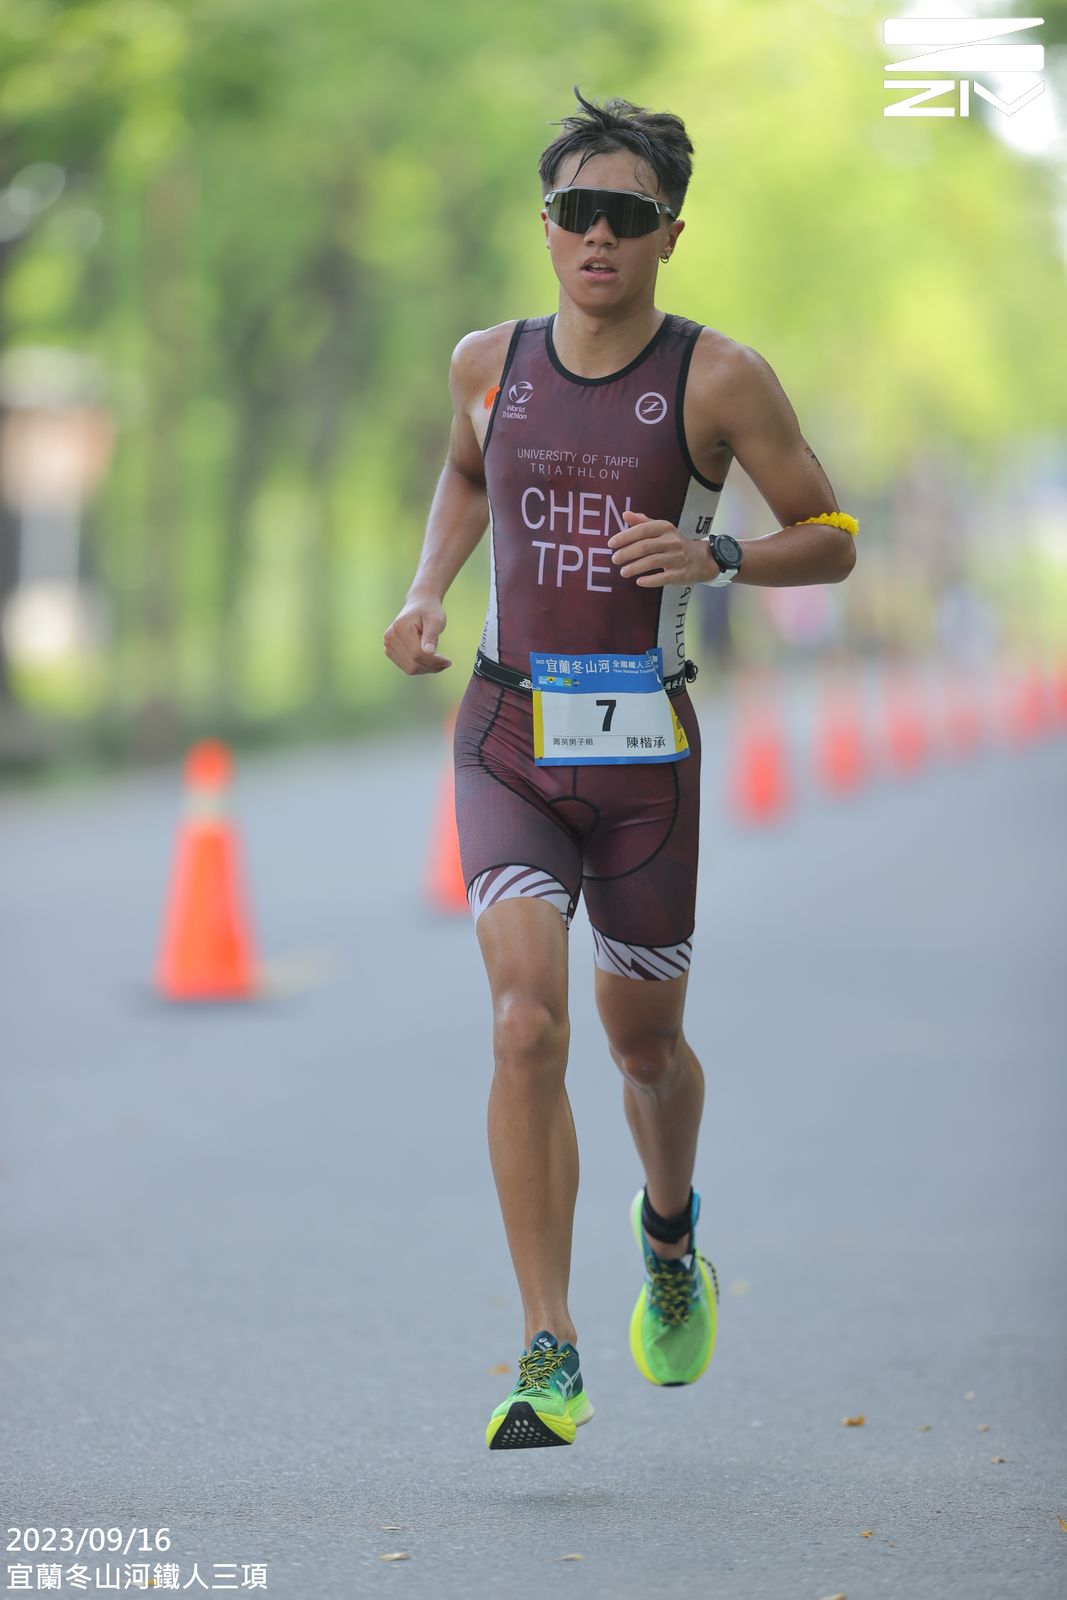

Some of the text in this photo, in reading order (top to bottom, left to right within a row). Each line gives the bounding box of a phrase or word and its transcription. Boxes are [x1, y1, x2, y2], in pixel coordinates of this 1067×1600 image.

[502, 411, 528, 420] Triathlon
[506, 404, 526, 413] World
[517, 448, 639, 468] UNIVERSITY OF TAIPEI
[530, 463, 620, 480] TRIATHLON
[521, 487, 631, 537] CHEN
[532, 540, 613, 593] TPE
[546, 658, 610, 674] 宜蘭冬山河
[596, 699, 617, 732] 7
[626, 736, 666, 749] 陳楷承
